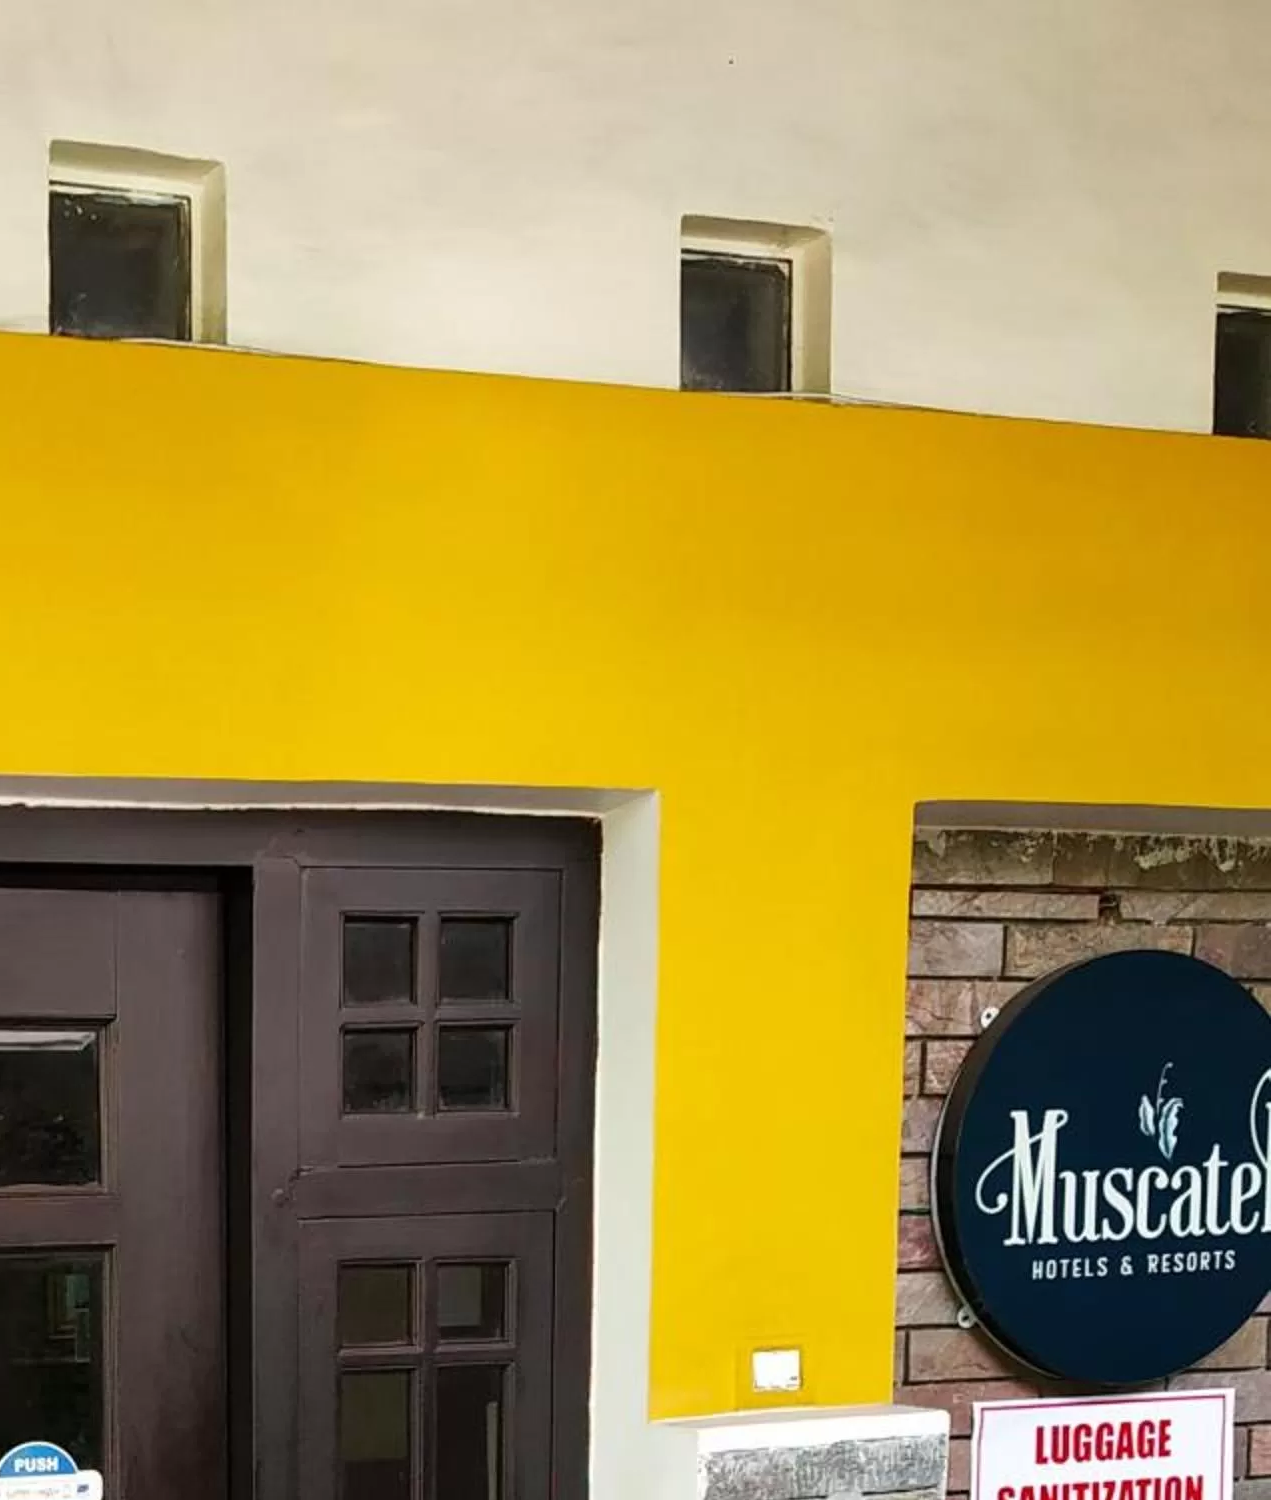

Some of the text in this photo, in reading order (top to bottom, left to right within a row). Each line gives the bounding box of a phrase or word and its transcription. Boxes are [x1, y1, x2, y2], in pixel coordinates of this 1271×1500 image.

[1031, 1249, 1237, 1281] HOTELS & RESORTS
[1034, 1418, 1172, 1466] LUGGAGE
[14, 1456, 59, 1473] PUSH
